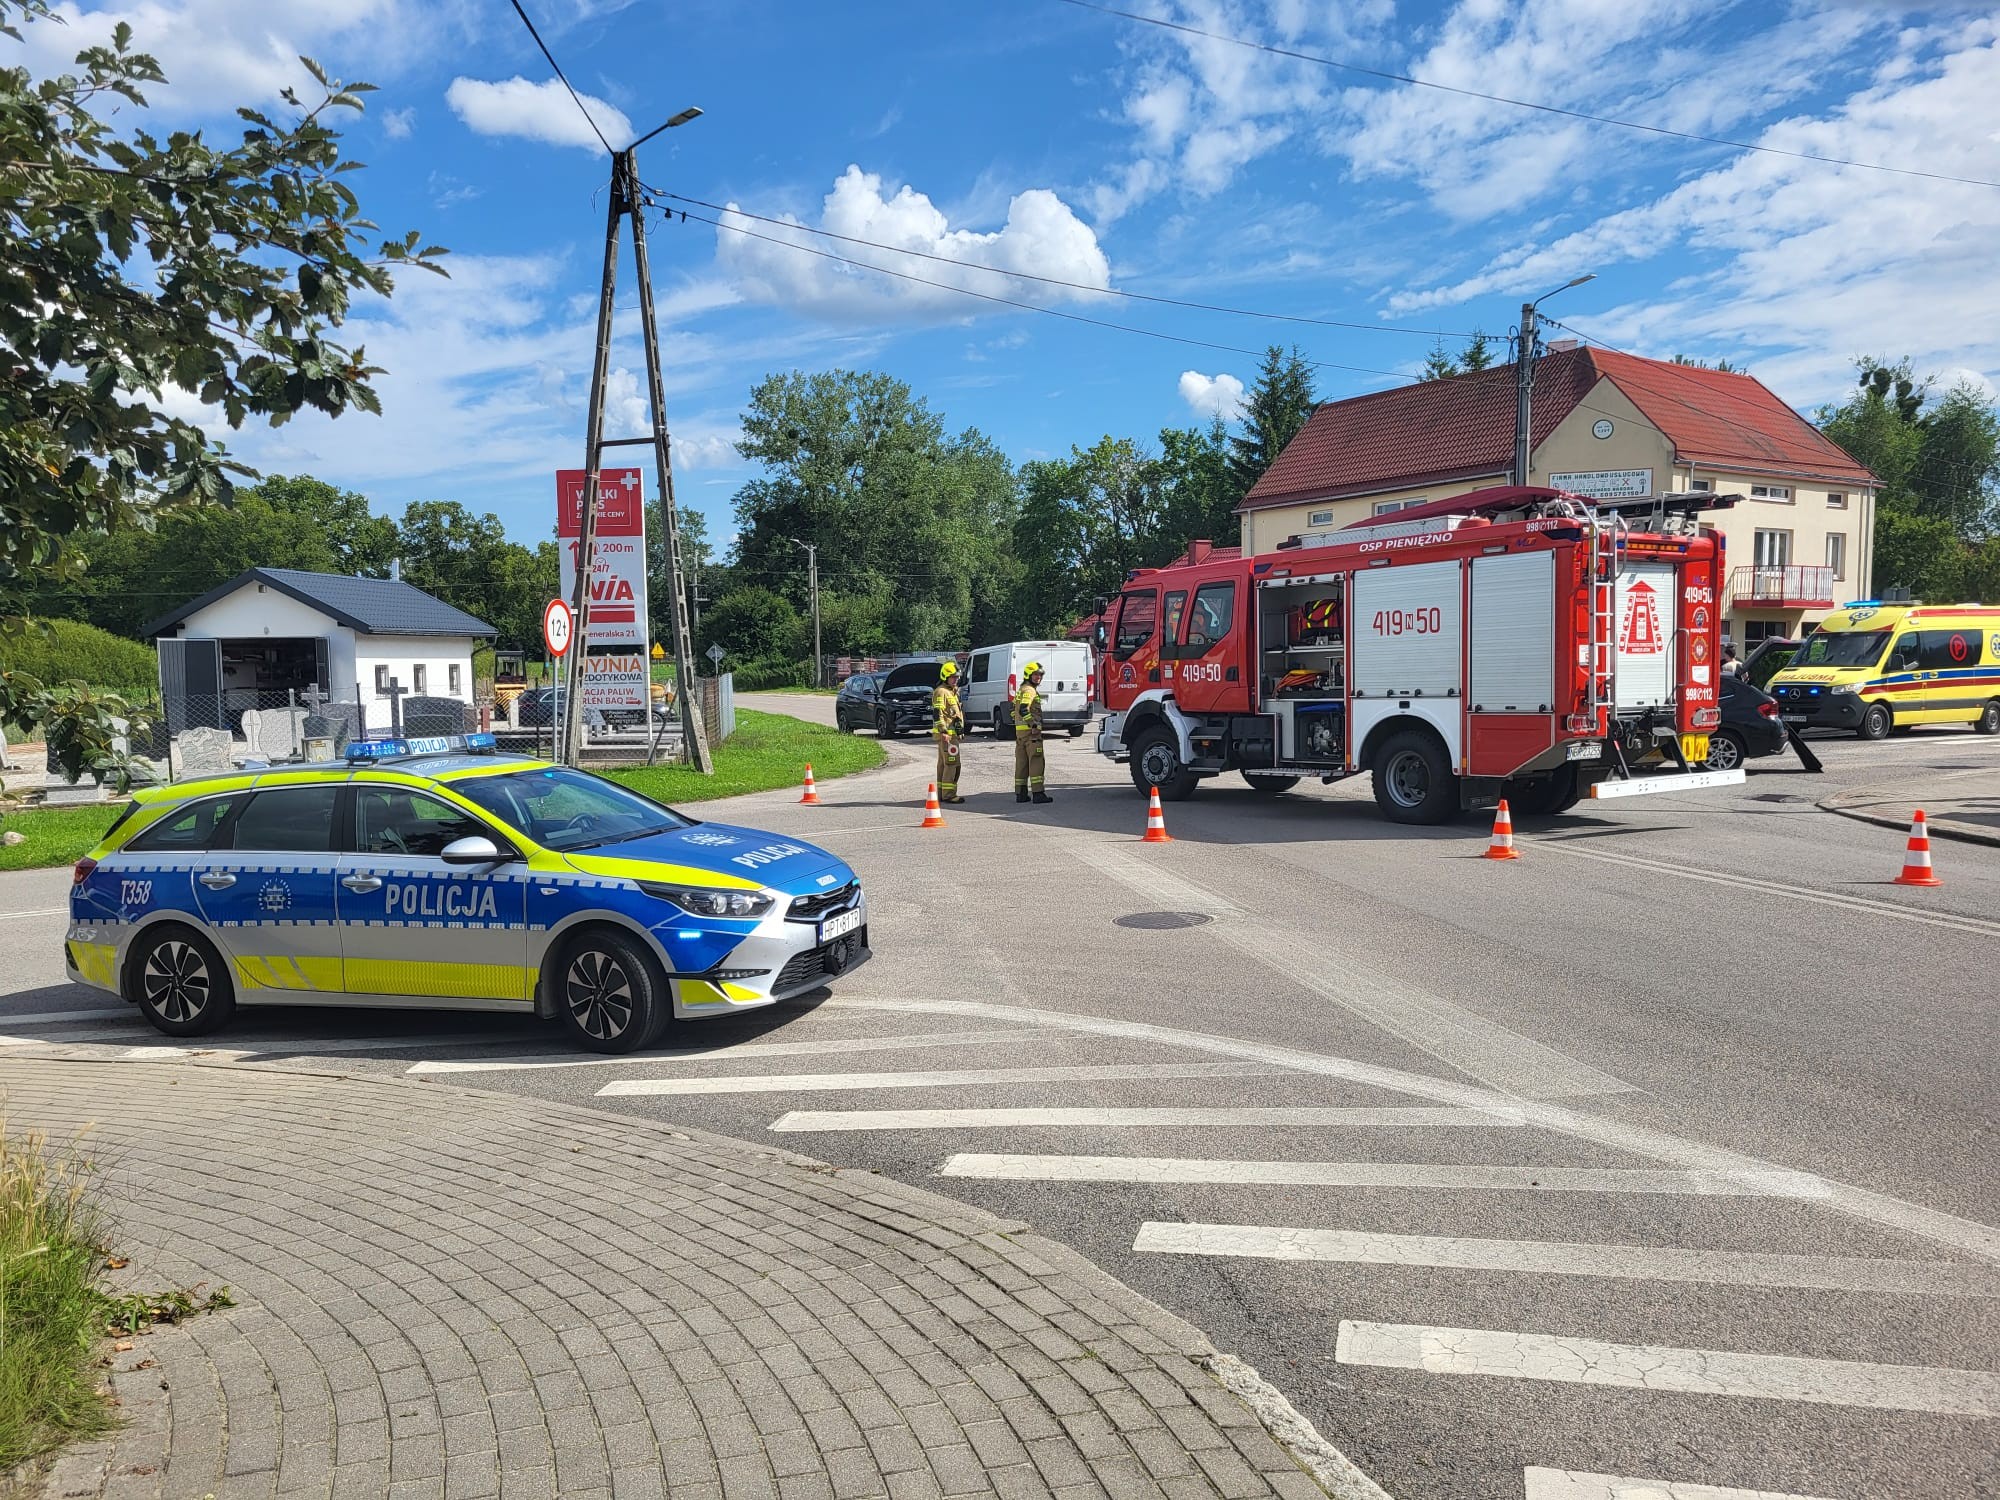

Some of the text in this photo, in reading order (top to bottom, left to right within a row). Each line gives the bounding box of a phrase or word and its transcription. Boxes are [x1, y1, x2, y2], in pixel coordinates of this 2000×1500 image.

[576, 489, 618, 500] WLKI
[576, 500, 605, 510] PS
[1526, 520, 1558, 532] 998 112
[603, 544, 622, 553] 200
[1359, 532, 1453, 552] OSP PIENIĘŻNO
[592, 564, 610, 573] 24/7
[552, 618, 566, 636] 12 t
[608, 688, 634, 696] PALIW
[1685, 688, 1713, 701] 998 112
[410, 738, 448, 753] POLICJA
[731, 843, 810, 869] POLICJA
[120, 880, 152, 905] T358
[386, 884, 498, 918] POLICJA
